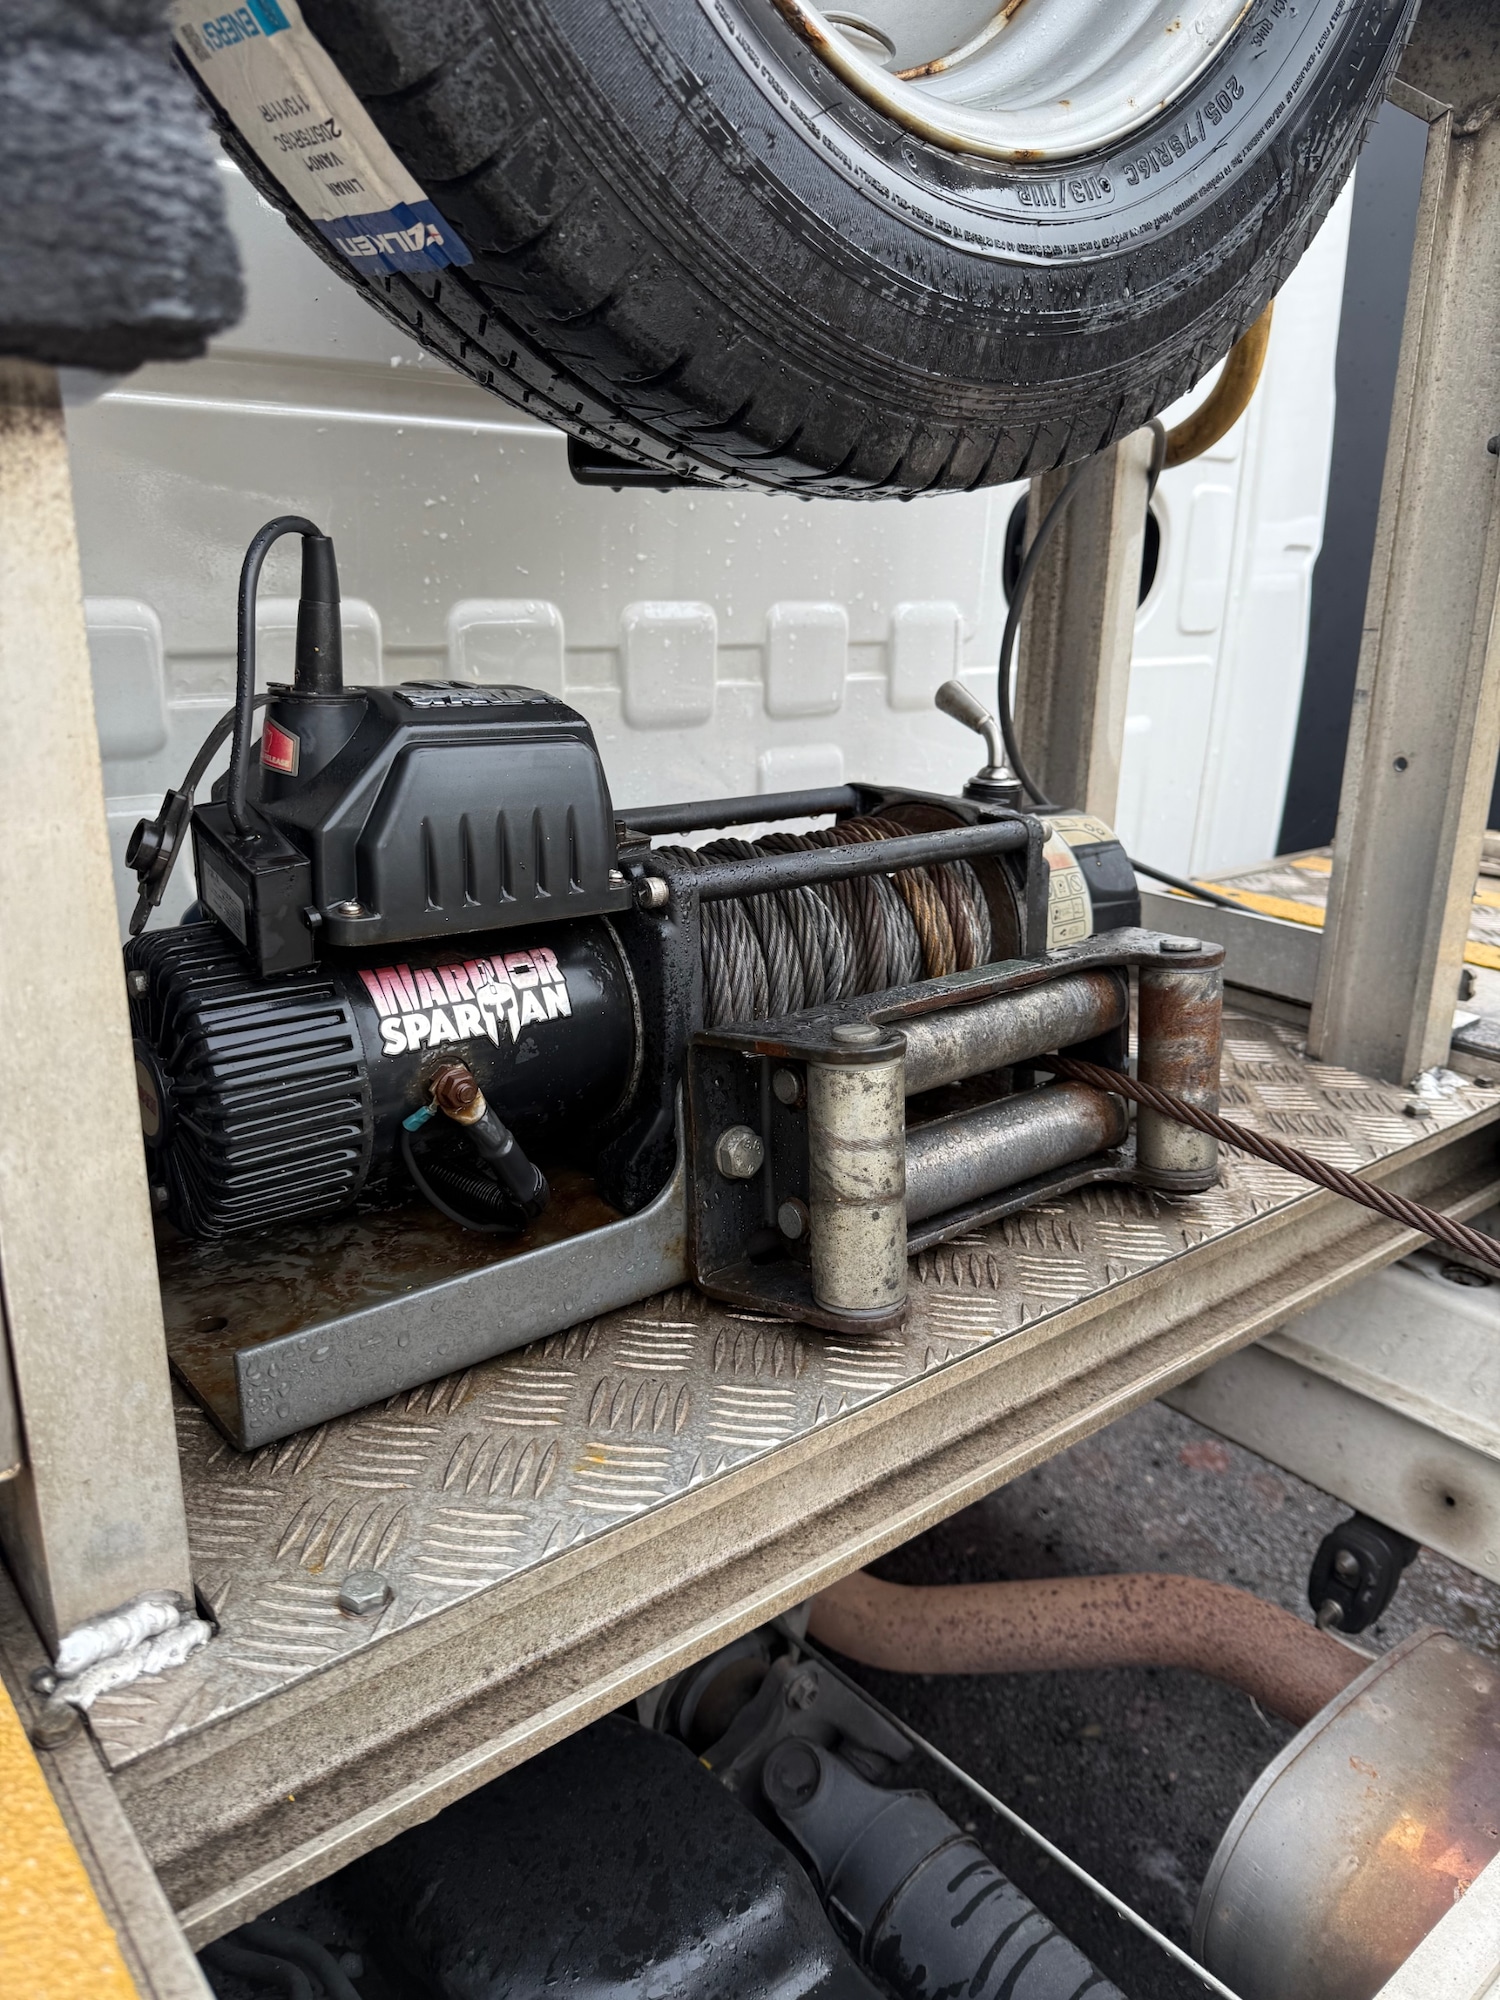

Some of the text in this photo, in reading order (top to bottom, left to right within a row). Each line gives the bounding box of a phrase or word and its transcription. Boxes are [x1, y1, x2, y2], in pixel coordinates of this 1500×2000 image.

[257, 94, 311, 123] 113/111R
[273, 117, 342, 152] 205/75R16C
[1123, 74, 1244, 186] 205/75R16C
[326, 178, 365, 197] LINAN
[357, 947, 566, 1018] WARRIOR
[380, 982, 573, 1056] SPARTAN
